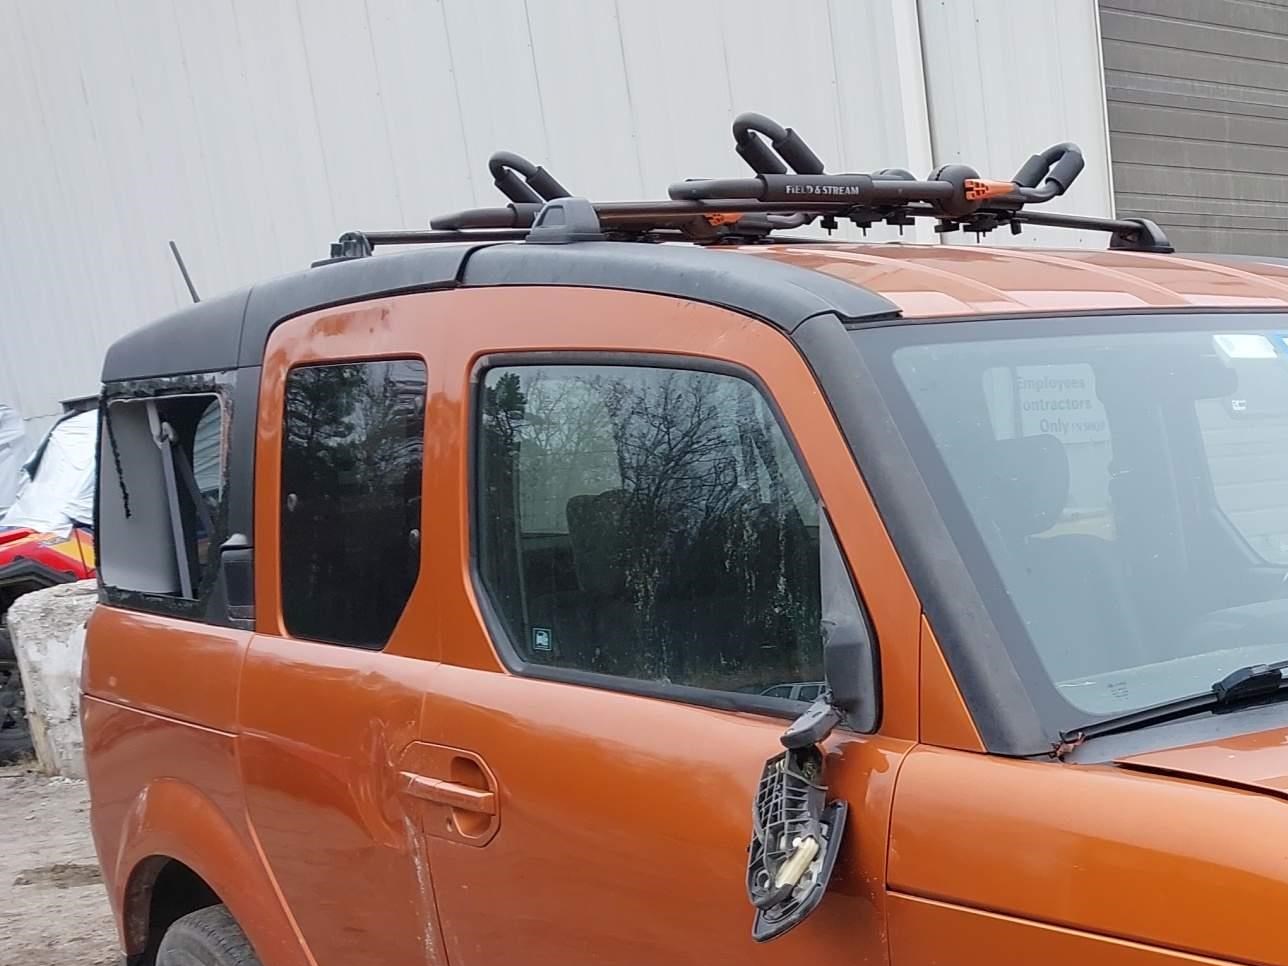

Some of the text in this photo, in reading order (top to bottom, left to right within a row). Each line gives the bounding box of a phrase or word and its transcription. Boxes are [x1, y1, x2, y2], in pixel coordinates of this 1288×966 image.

[785, 185, 859, 196] FIELD & STREAM
[1022, 399, 1095, 412] ontractors
[1040, 415, 1067, 434] Only
